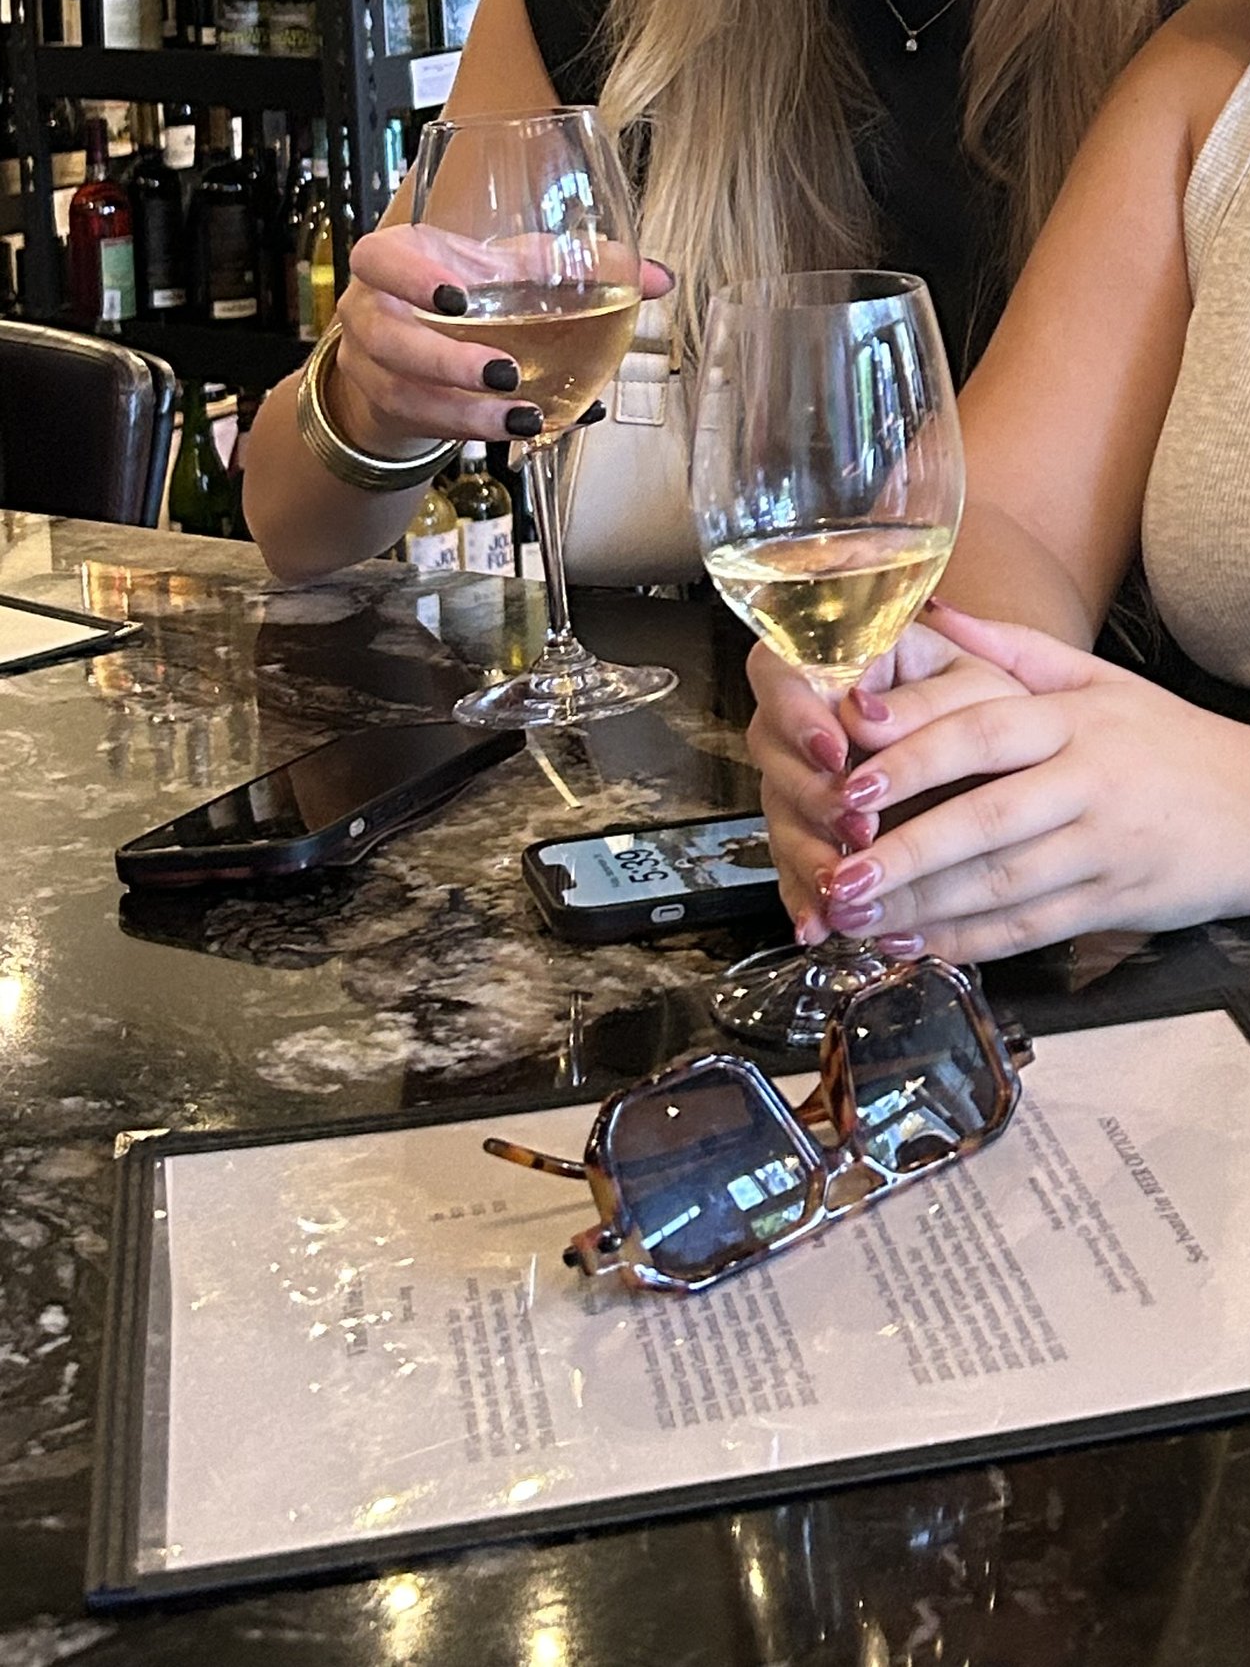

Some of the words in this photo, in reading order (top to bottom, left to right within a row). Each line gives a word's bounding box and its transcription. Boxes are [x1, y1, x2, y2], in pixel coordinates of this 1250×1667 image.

[614, 849, 670, 884] 5:39
[1129, 1167, 1165, 1195] BEER
[1158, 1211, 1196, 1242] board
